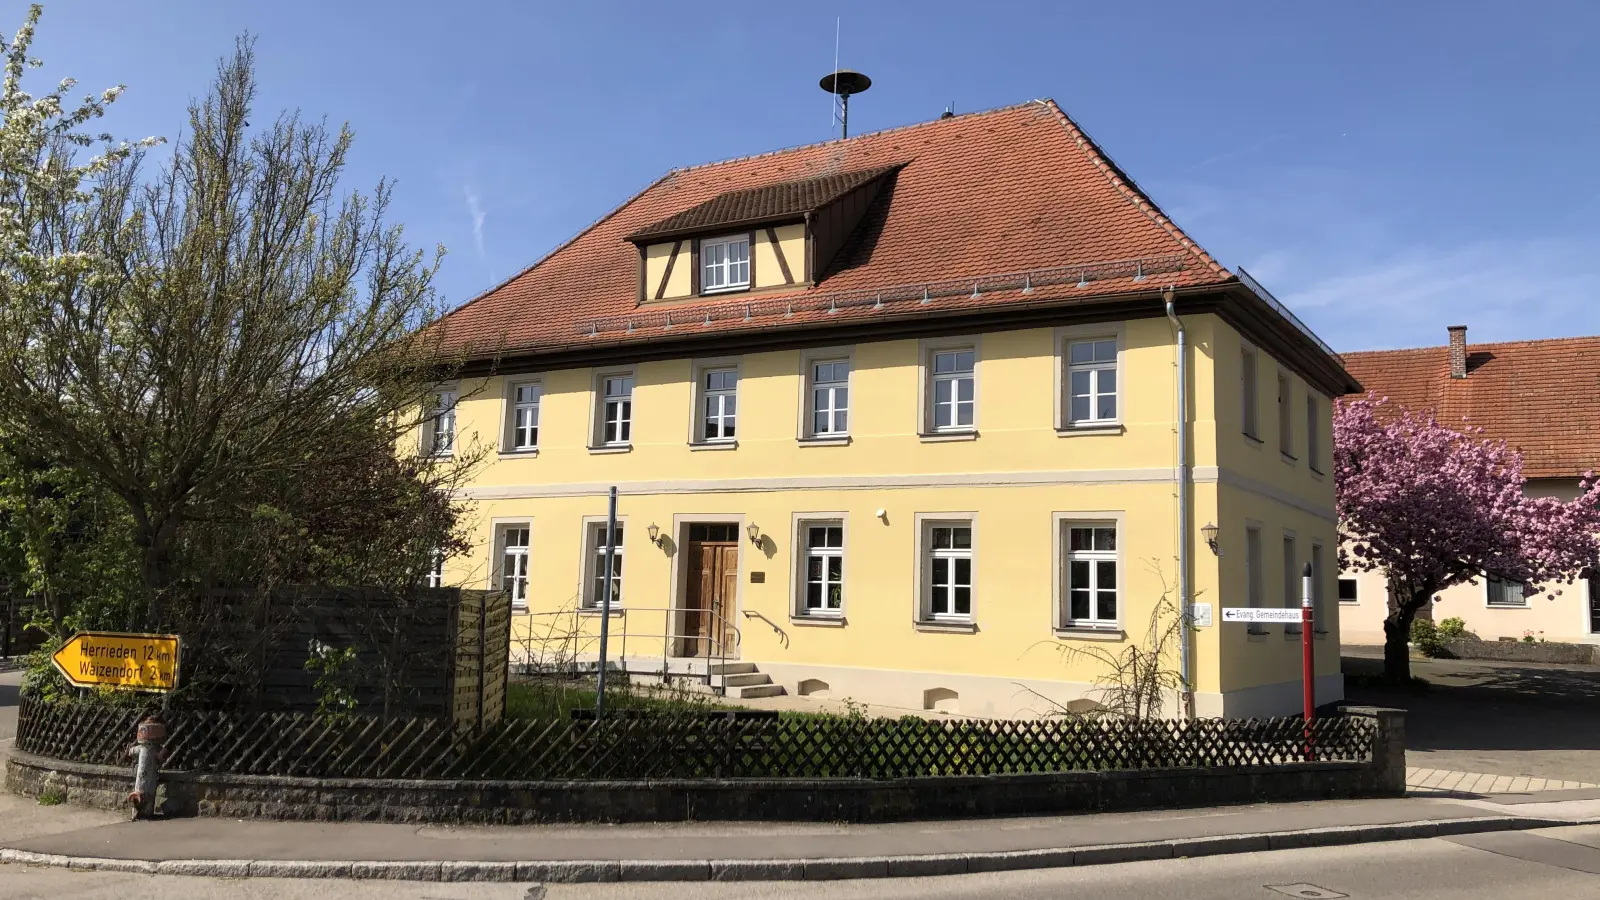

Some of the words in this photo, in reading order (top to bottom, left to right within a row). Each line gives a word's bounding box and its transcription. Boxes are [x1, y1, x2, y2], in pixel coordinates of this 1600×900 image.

[1236, 609, 1255, 620] Evang.
[1256, 609, 1300, 620] Gemeindehaus
[80, 641, 137, 659] Herrieden
[143, 645, 154, 660] 12
[156, 650, 170, 662] km
[79, 660, 144, 679] Waizendorf
[150, 665, 156, 680] 2
[160, 671, 171, 681] km
